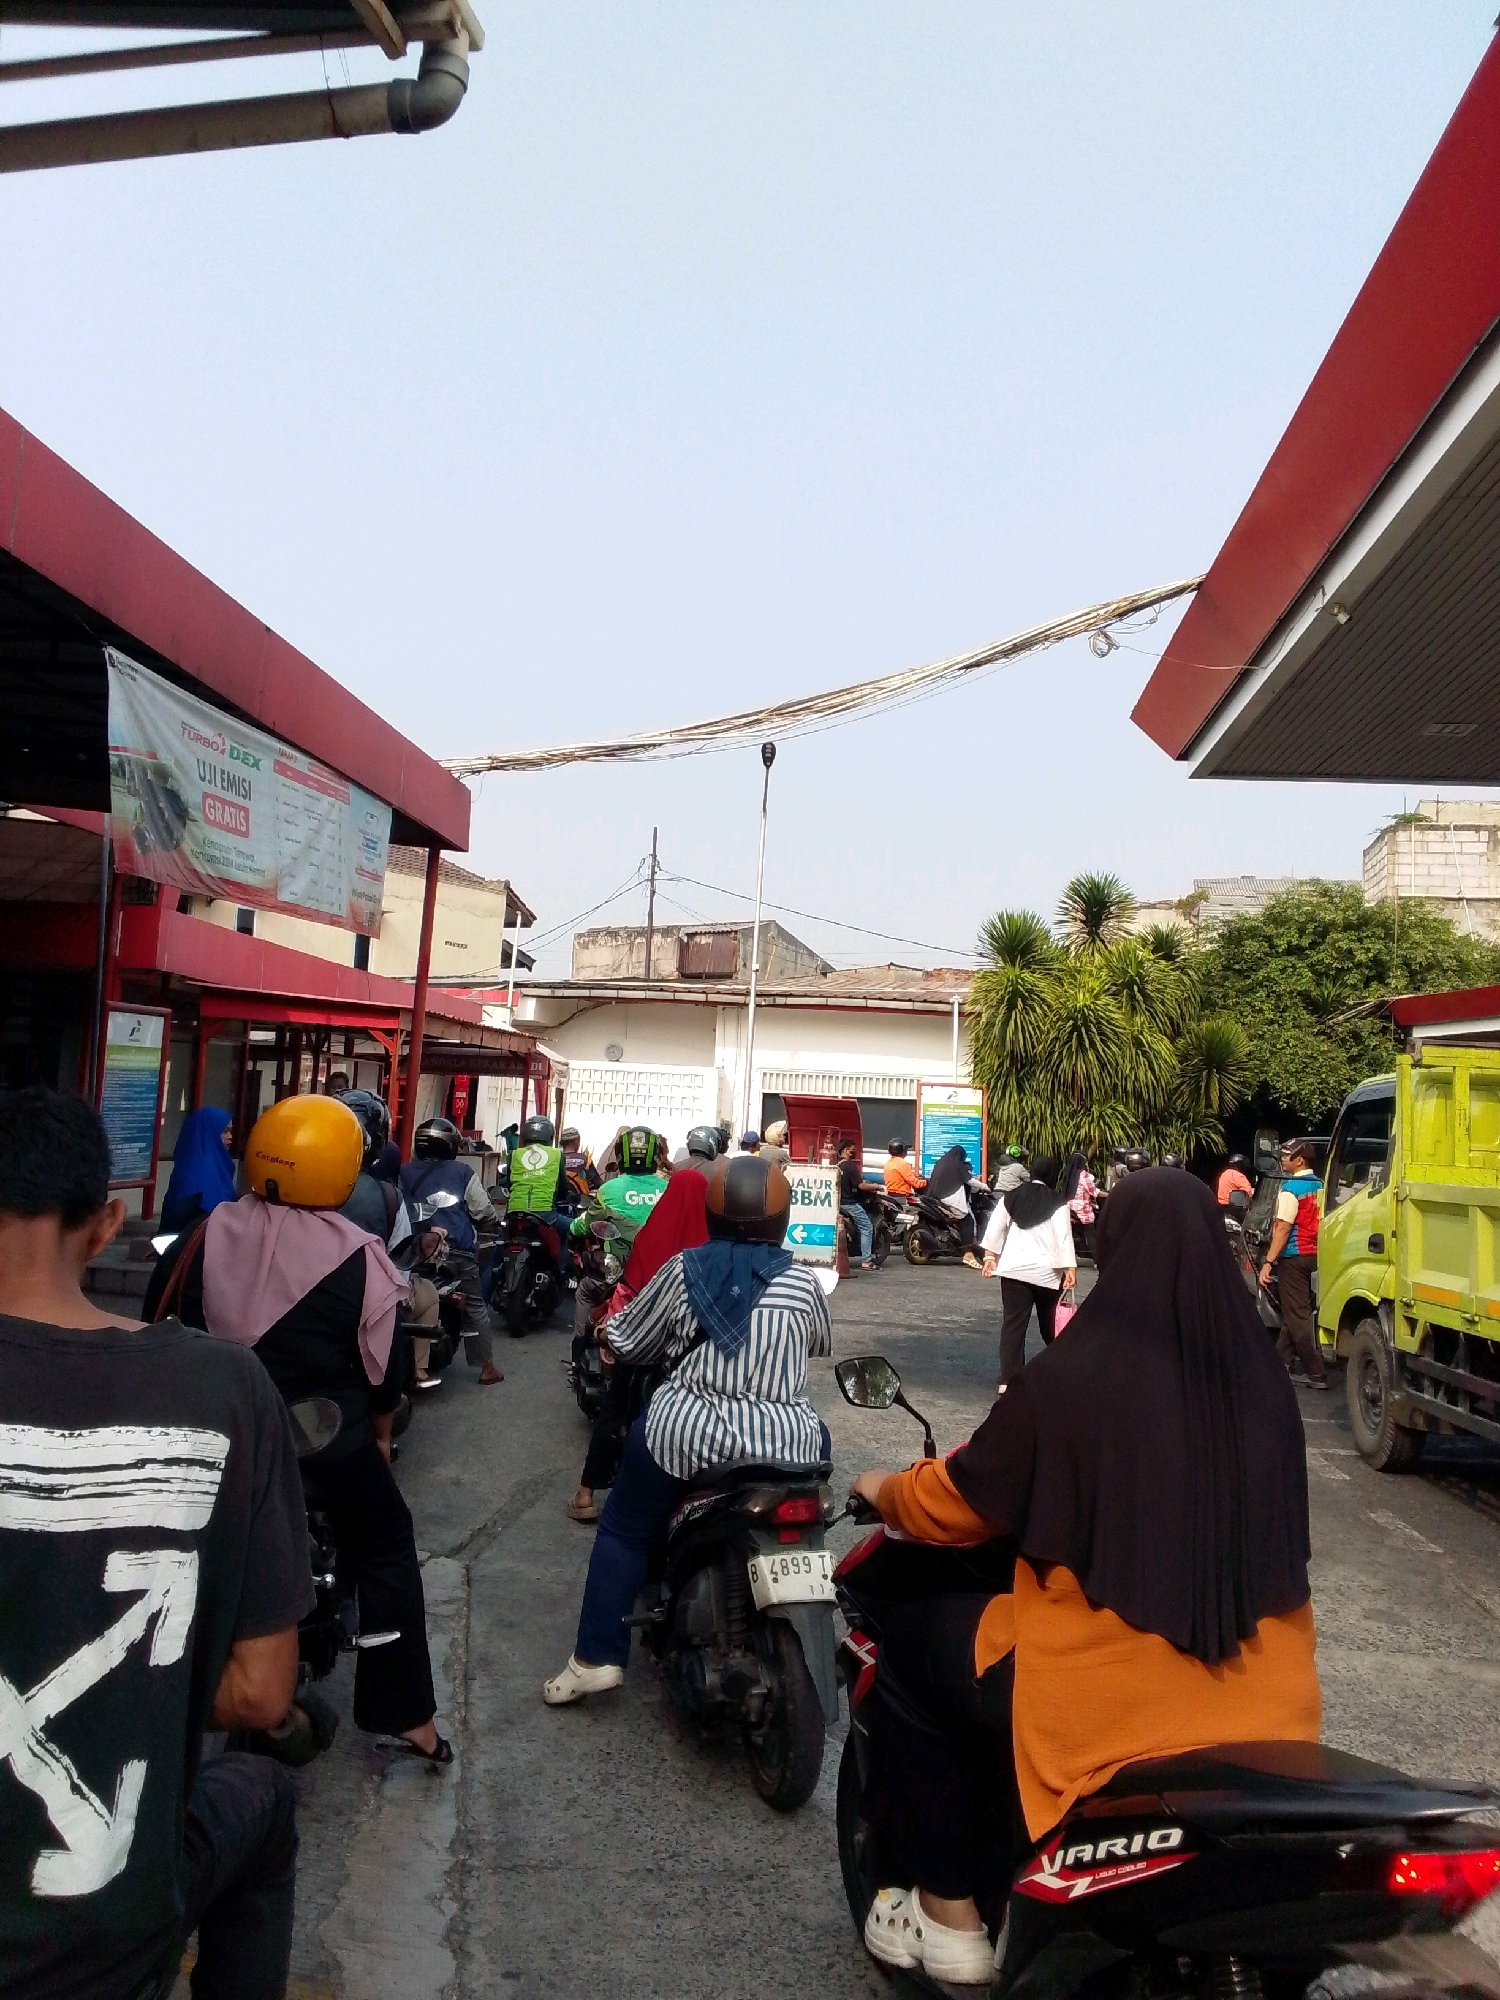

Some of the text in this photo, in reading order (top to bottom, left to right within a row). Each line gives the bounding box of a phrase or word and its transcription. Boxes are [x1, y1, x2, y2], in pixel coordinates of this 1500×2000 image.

[181, 725, 220, 752] TURBO
[229, 743, 262, 772] DEX
[196, 757, 218, 788] UJI
[220, 768, 251, 801] EMISI
[205, 797, 247, 832] GRATIS
[790, 1178, 832, 1190] JALUR
[790, 1189, 833, 1208] BBM
[750, 1563, 759, 1584] B
[770, 1555, 812, 1578] 4899
[1041, 1827, 1184, 1875] VARIO
